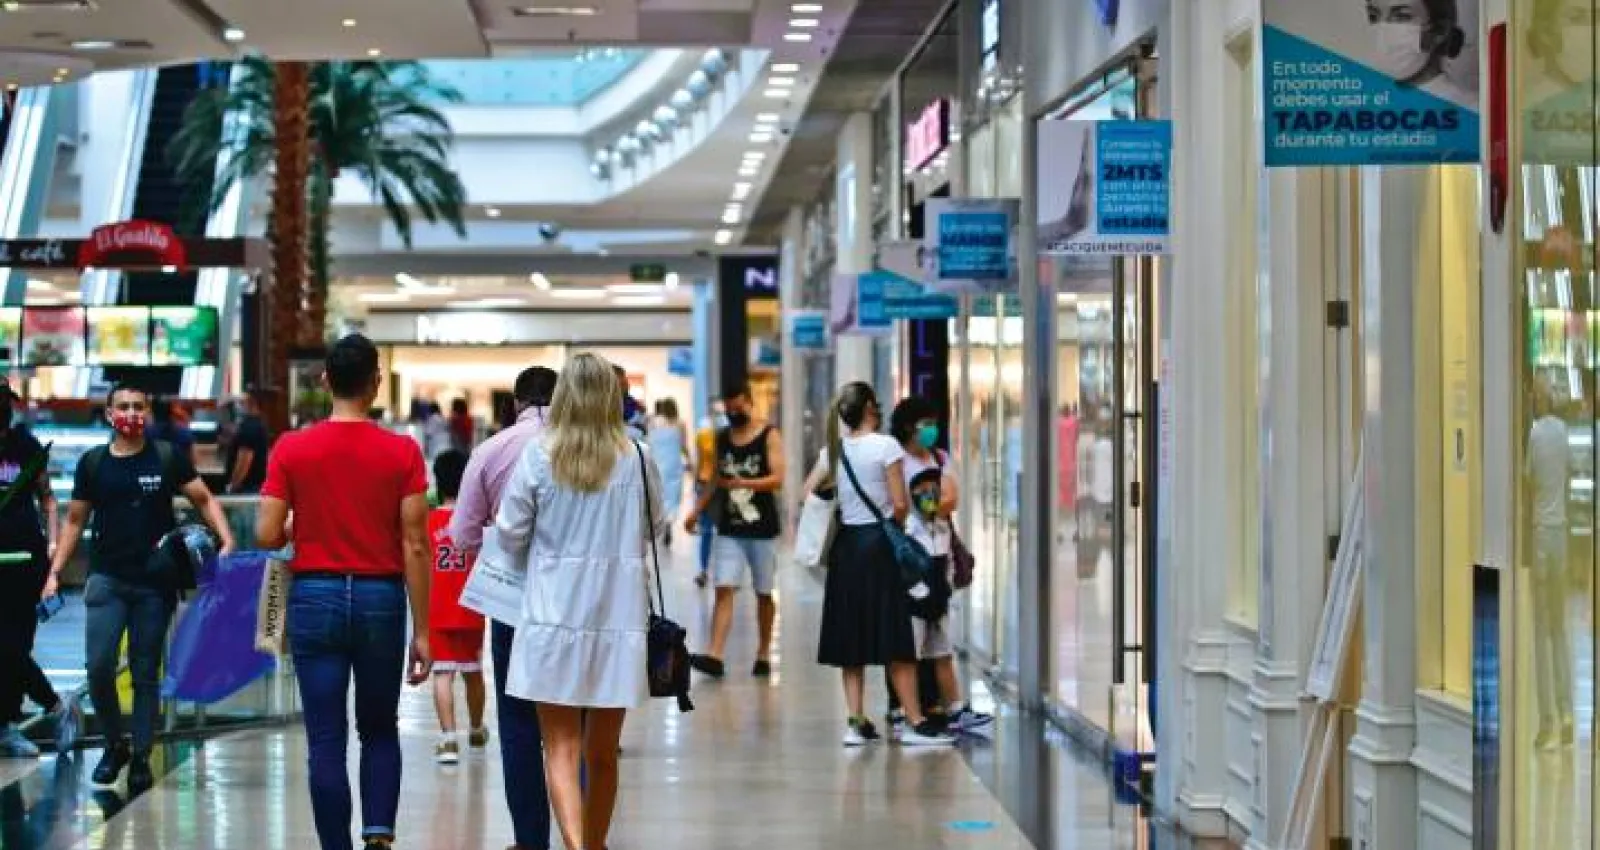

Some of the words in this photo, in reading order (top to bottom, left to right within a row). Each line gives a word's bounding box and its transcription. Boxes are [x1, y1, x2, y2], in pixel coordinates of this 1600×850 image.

[1273, 61, 1297, 76] En
[1300, 60, 1342, 75] todo
[1273, 78, 1362, 91] momento
[1273, 92, 1328, 107] debes
[1331, 93, 1367, 105] usar
[1373, 90, 1391, 105] el
[1273, 109, 1461, 131] TAPABOCAS
[1275, 132, 1346, 148] durante
[1350, 132, 1370, 146] tu
[1103, 164, 1163, 180] 2MTS
